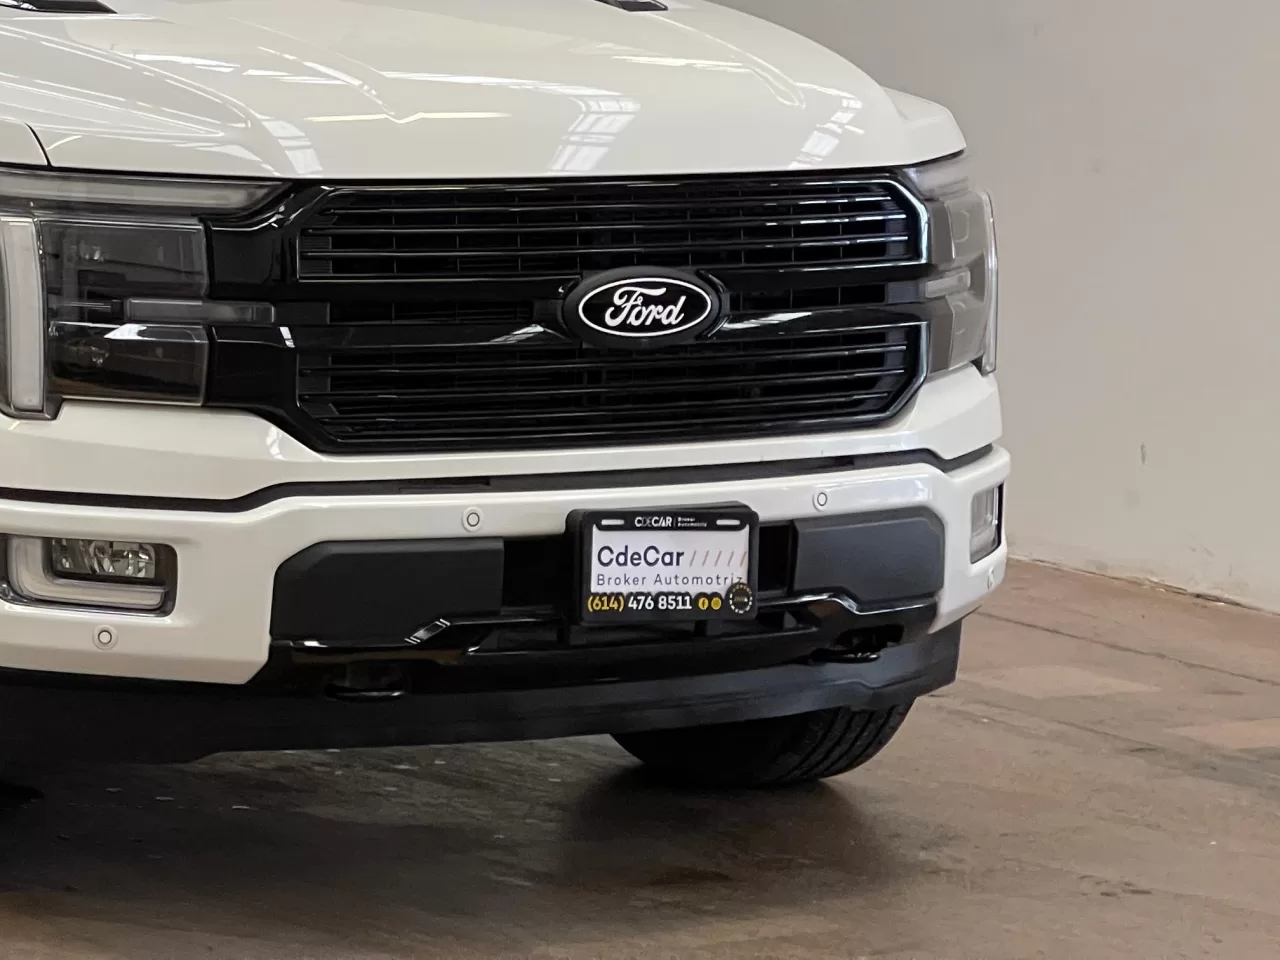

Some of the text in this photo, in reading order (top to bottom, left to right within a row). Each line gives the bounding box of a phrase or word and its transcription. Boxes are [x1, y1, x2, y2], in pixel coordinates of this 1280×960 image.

[604, 286, 687, 327] Ford
[597, 545, 685, 567] CdeCar
[596, 573, 743, 586] Broker Automotriz
[587, 595, 693, 613] (614) 476 8511
